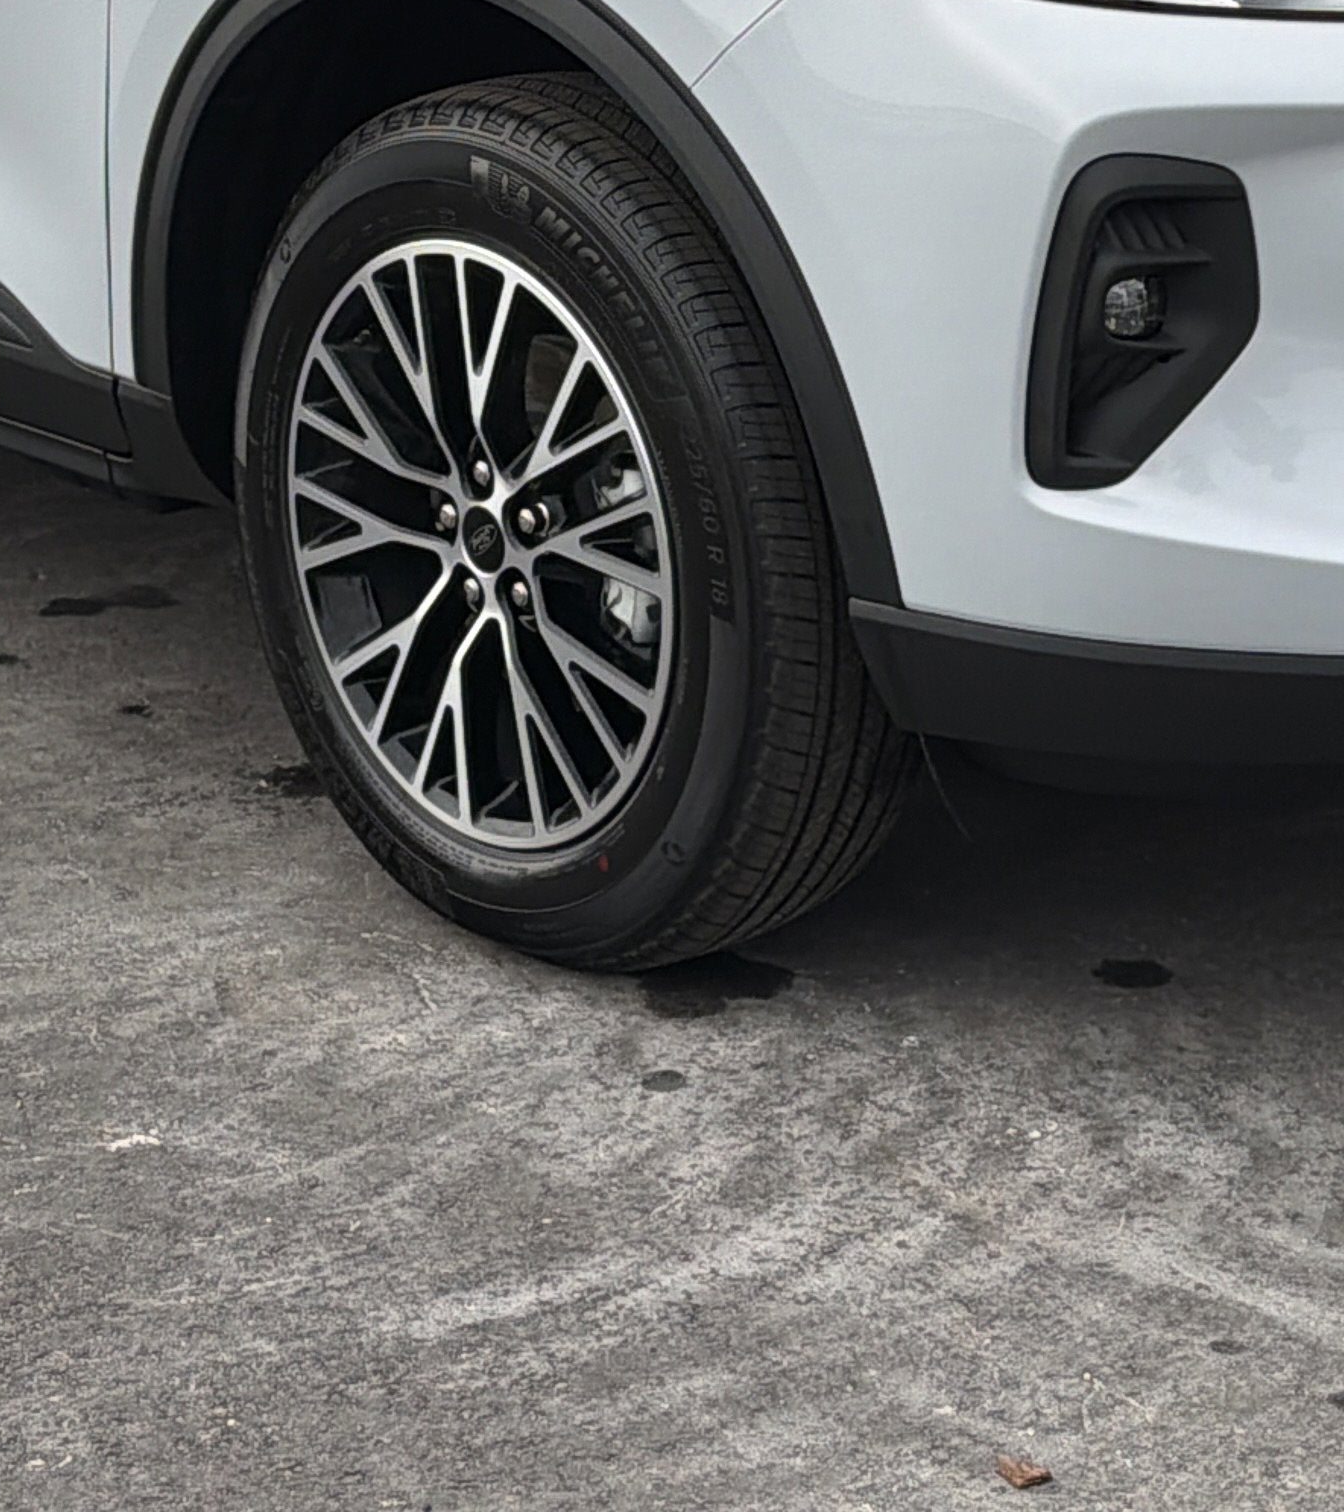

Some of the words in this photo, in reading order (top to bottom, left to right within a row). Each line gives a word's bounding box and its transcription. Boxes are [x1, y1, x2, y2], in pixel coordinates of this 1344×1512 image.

[534, 205, 671, 380] MICHELIN
[707, 545, 725, 564] R
[710, 579, 729, 606] 18
